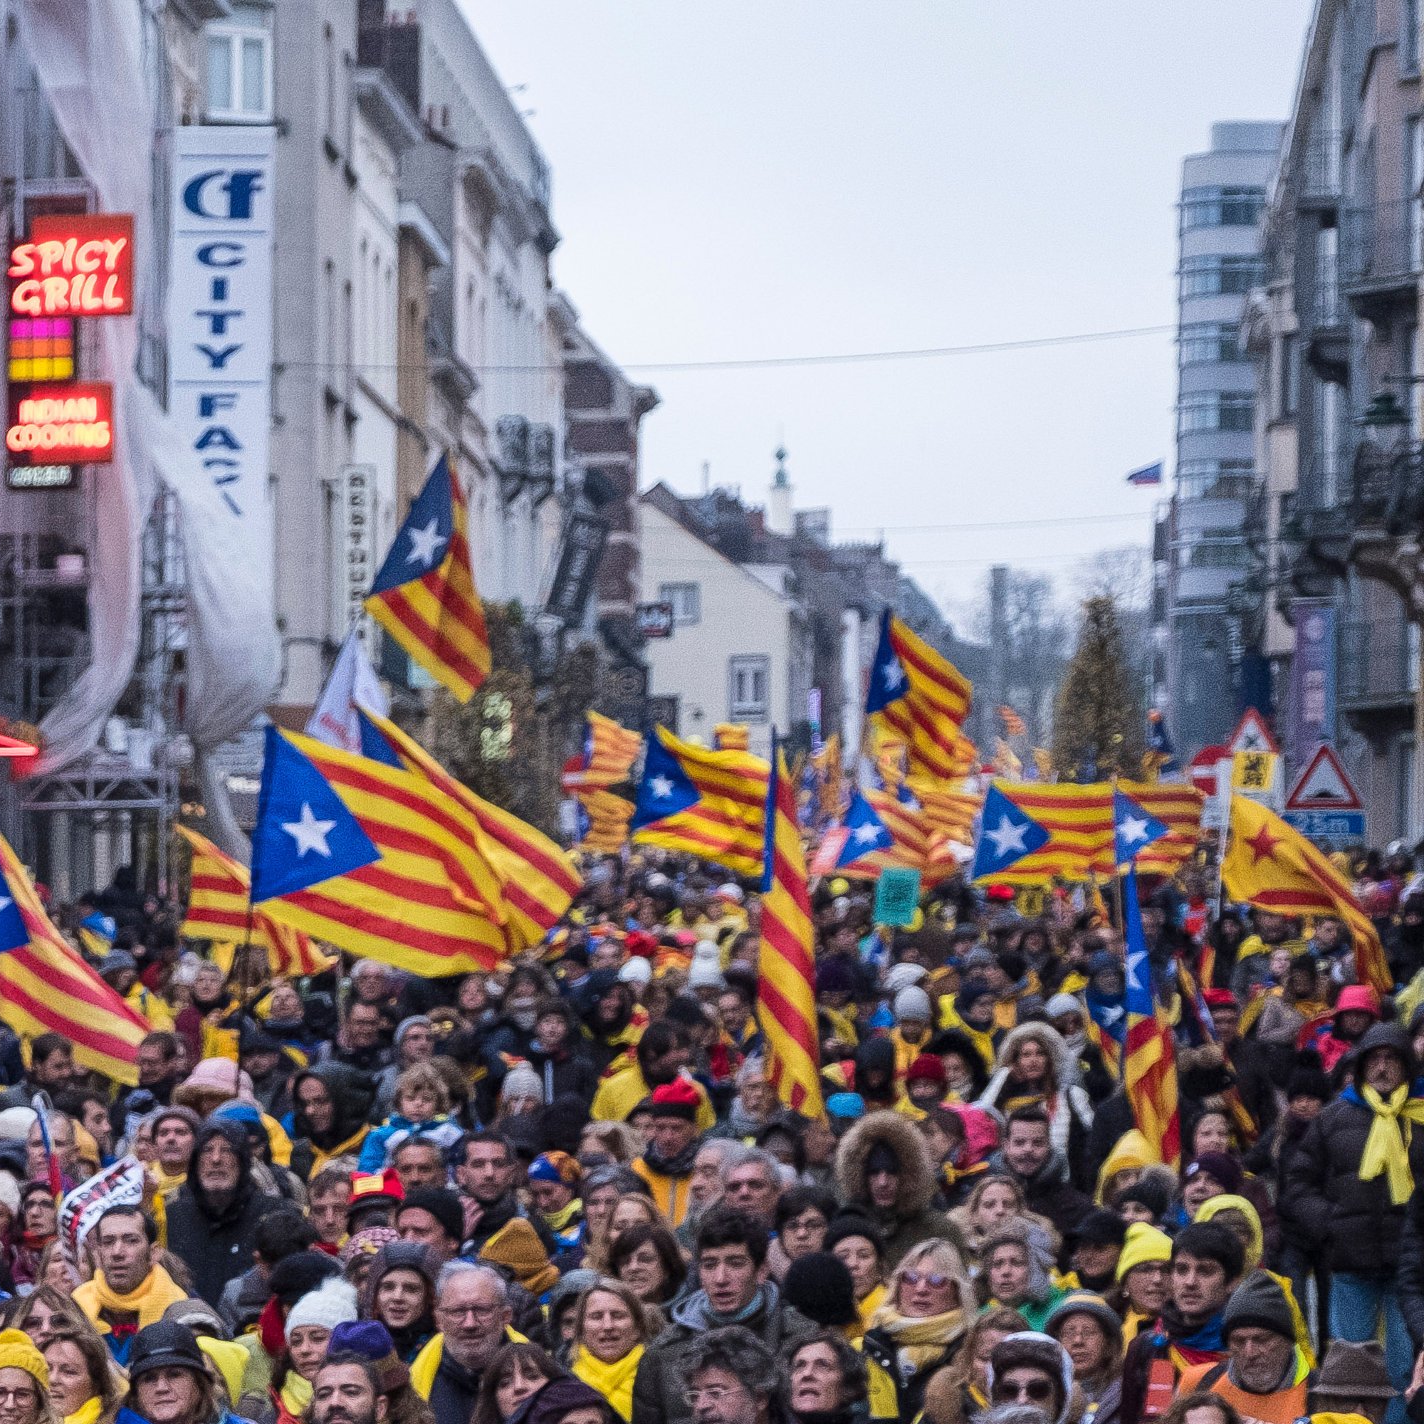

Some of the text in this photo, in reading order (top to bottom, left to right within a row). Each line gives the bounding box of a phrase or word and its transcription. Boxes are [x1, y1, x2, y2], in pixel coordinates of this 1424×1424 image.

[7, 237, 128, 277] SPICY
[11, 273, 124, 316] GRILL
[195, 242, 245, 369] CITY
[18, 398, 97, 424] INDIAN
[6, 421, 111, 451] COOKING
